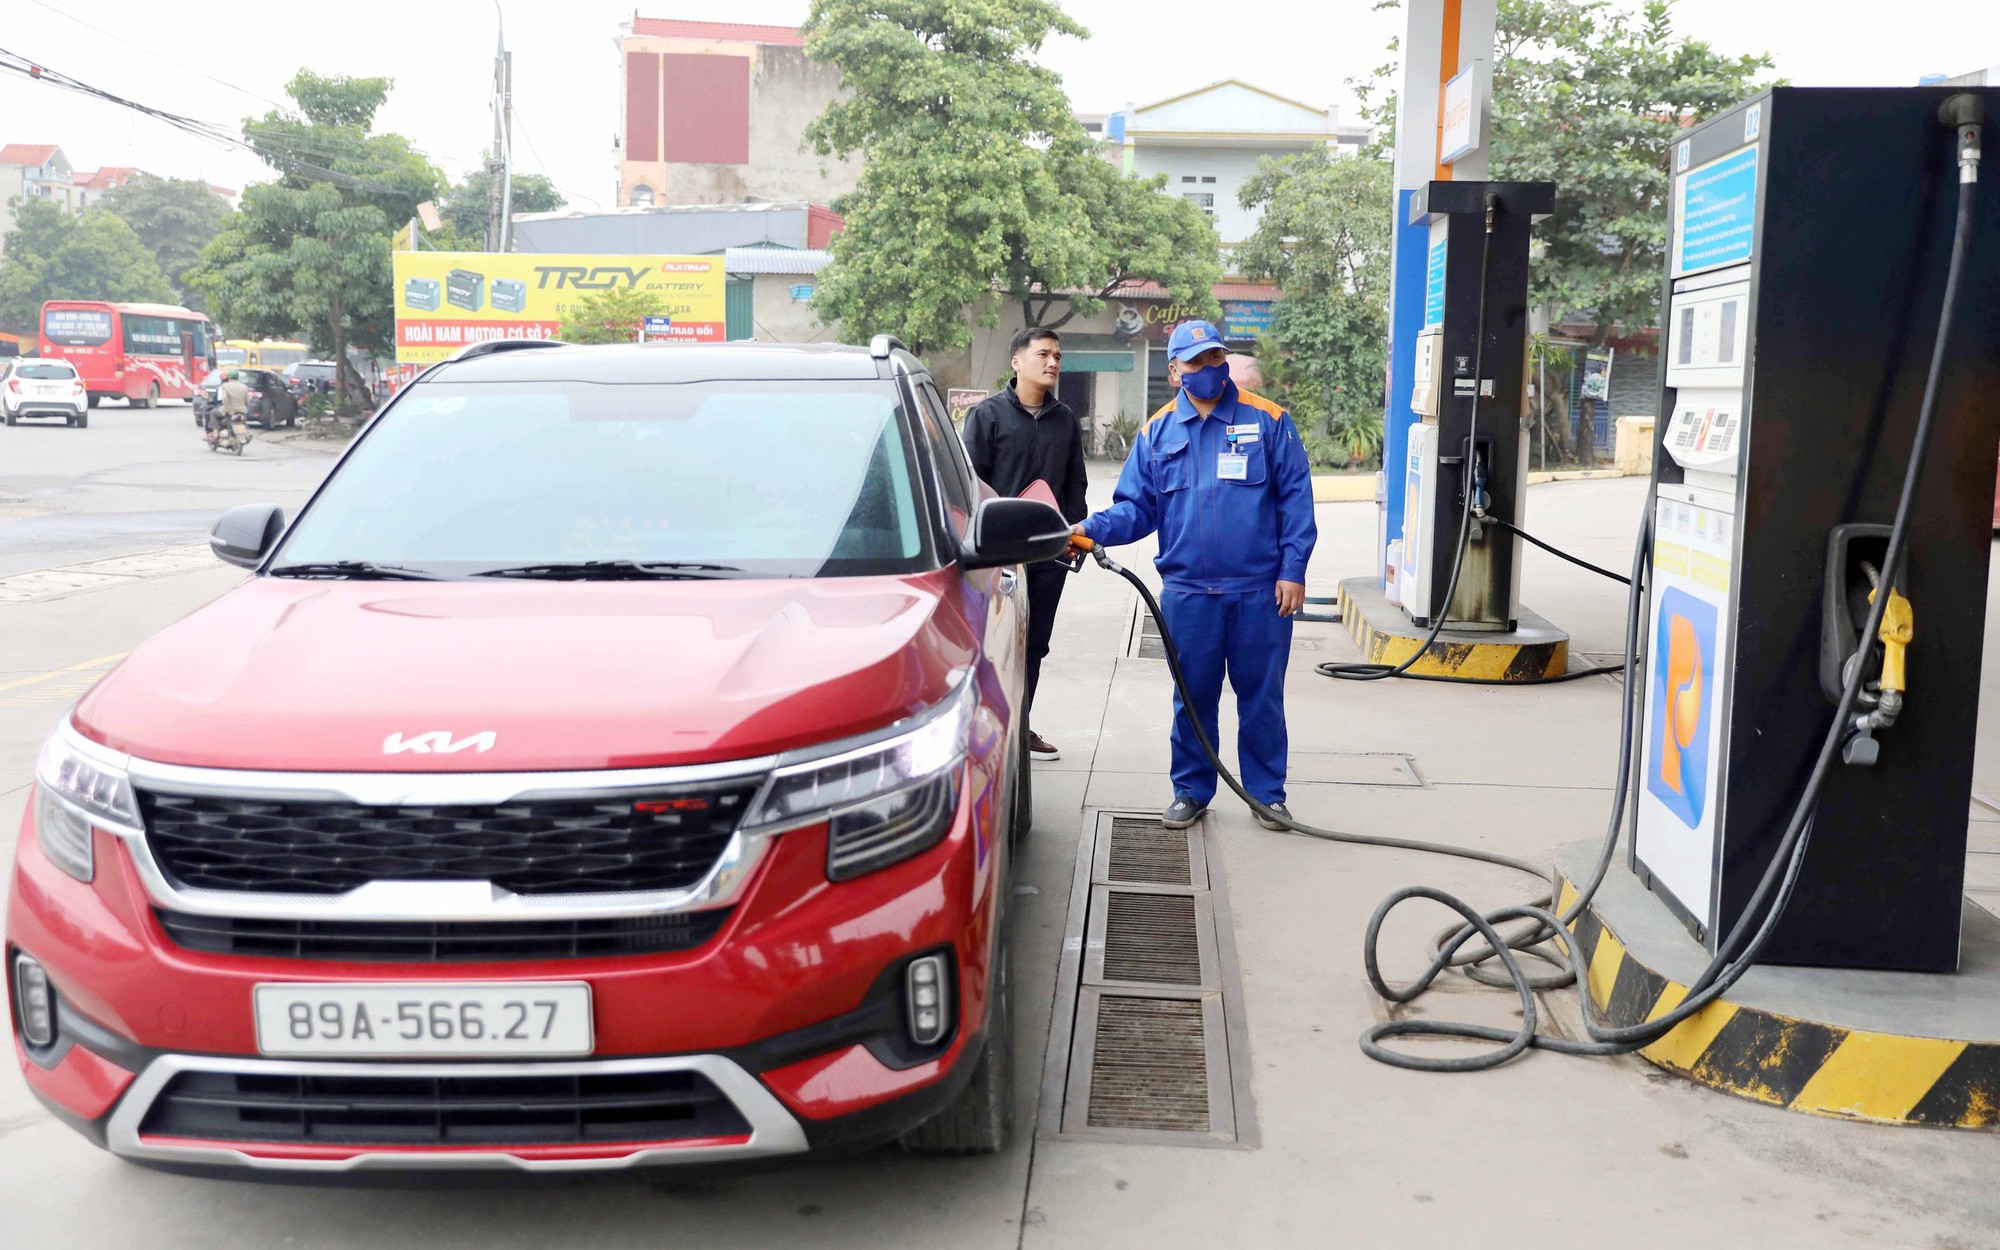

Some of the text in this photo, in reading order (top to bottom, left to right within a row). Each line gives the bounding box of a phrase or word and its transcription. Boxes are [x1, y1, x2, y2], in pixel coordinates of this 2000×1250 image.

[1746, 110, 1759, 136] 02
[1680, 144, 1689, 167] 03
[665, 263, 710, 271] PLATINUM
[534, 266, 652, 289] TROY
[448, 286, 472, 297] TROY
[492, 292, 516, 301] TROY
[1146, 304, 1198, 324] Caffee
[405, 323, 432, 341] HOÀI
[435, 326, 461, 341] NAM
[464, 327, 504, 341] MOTOR
[671, 327, 694, 335] TRAO
[288, 1001, 558, 1039] 89A-566.27
